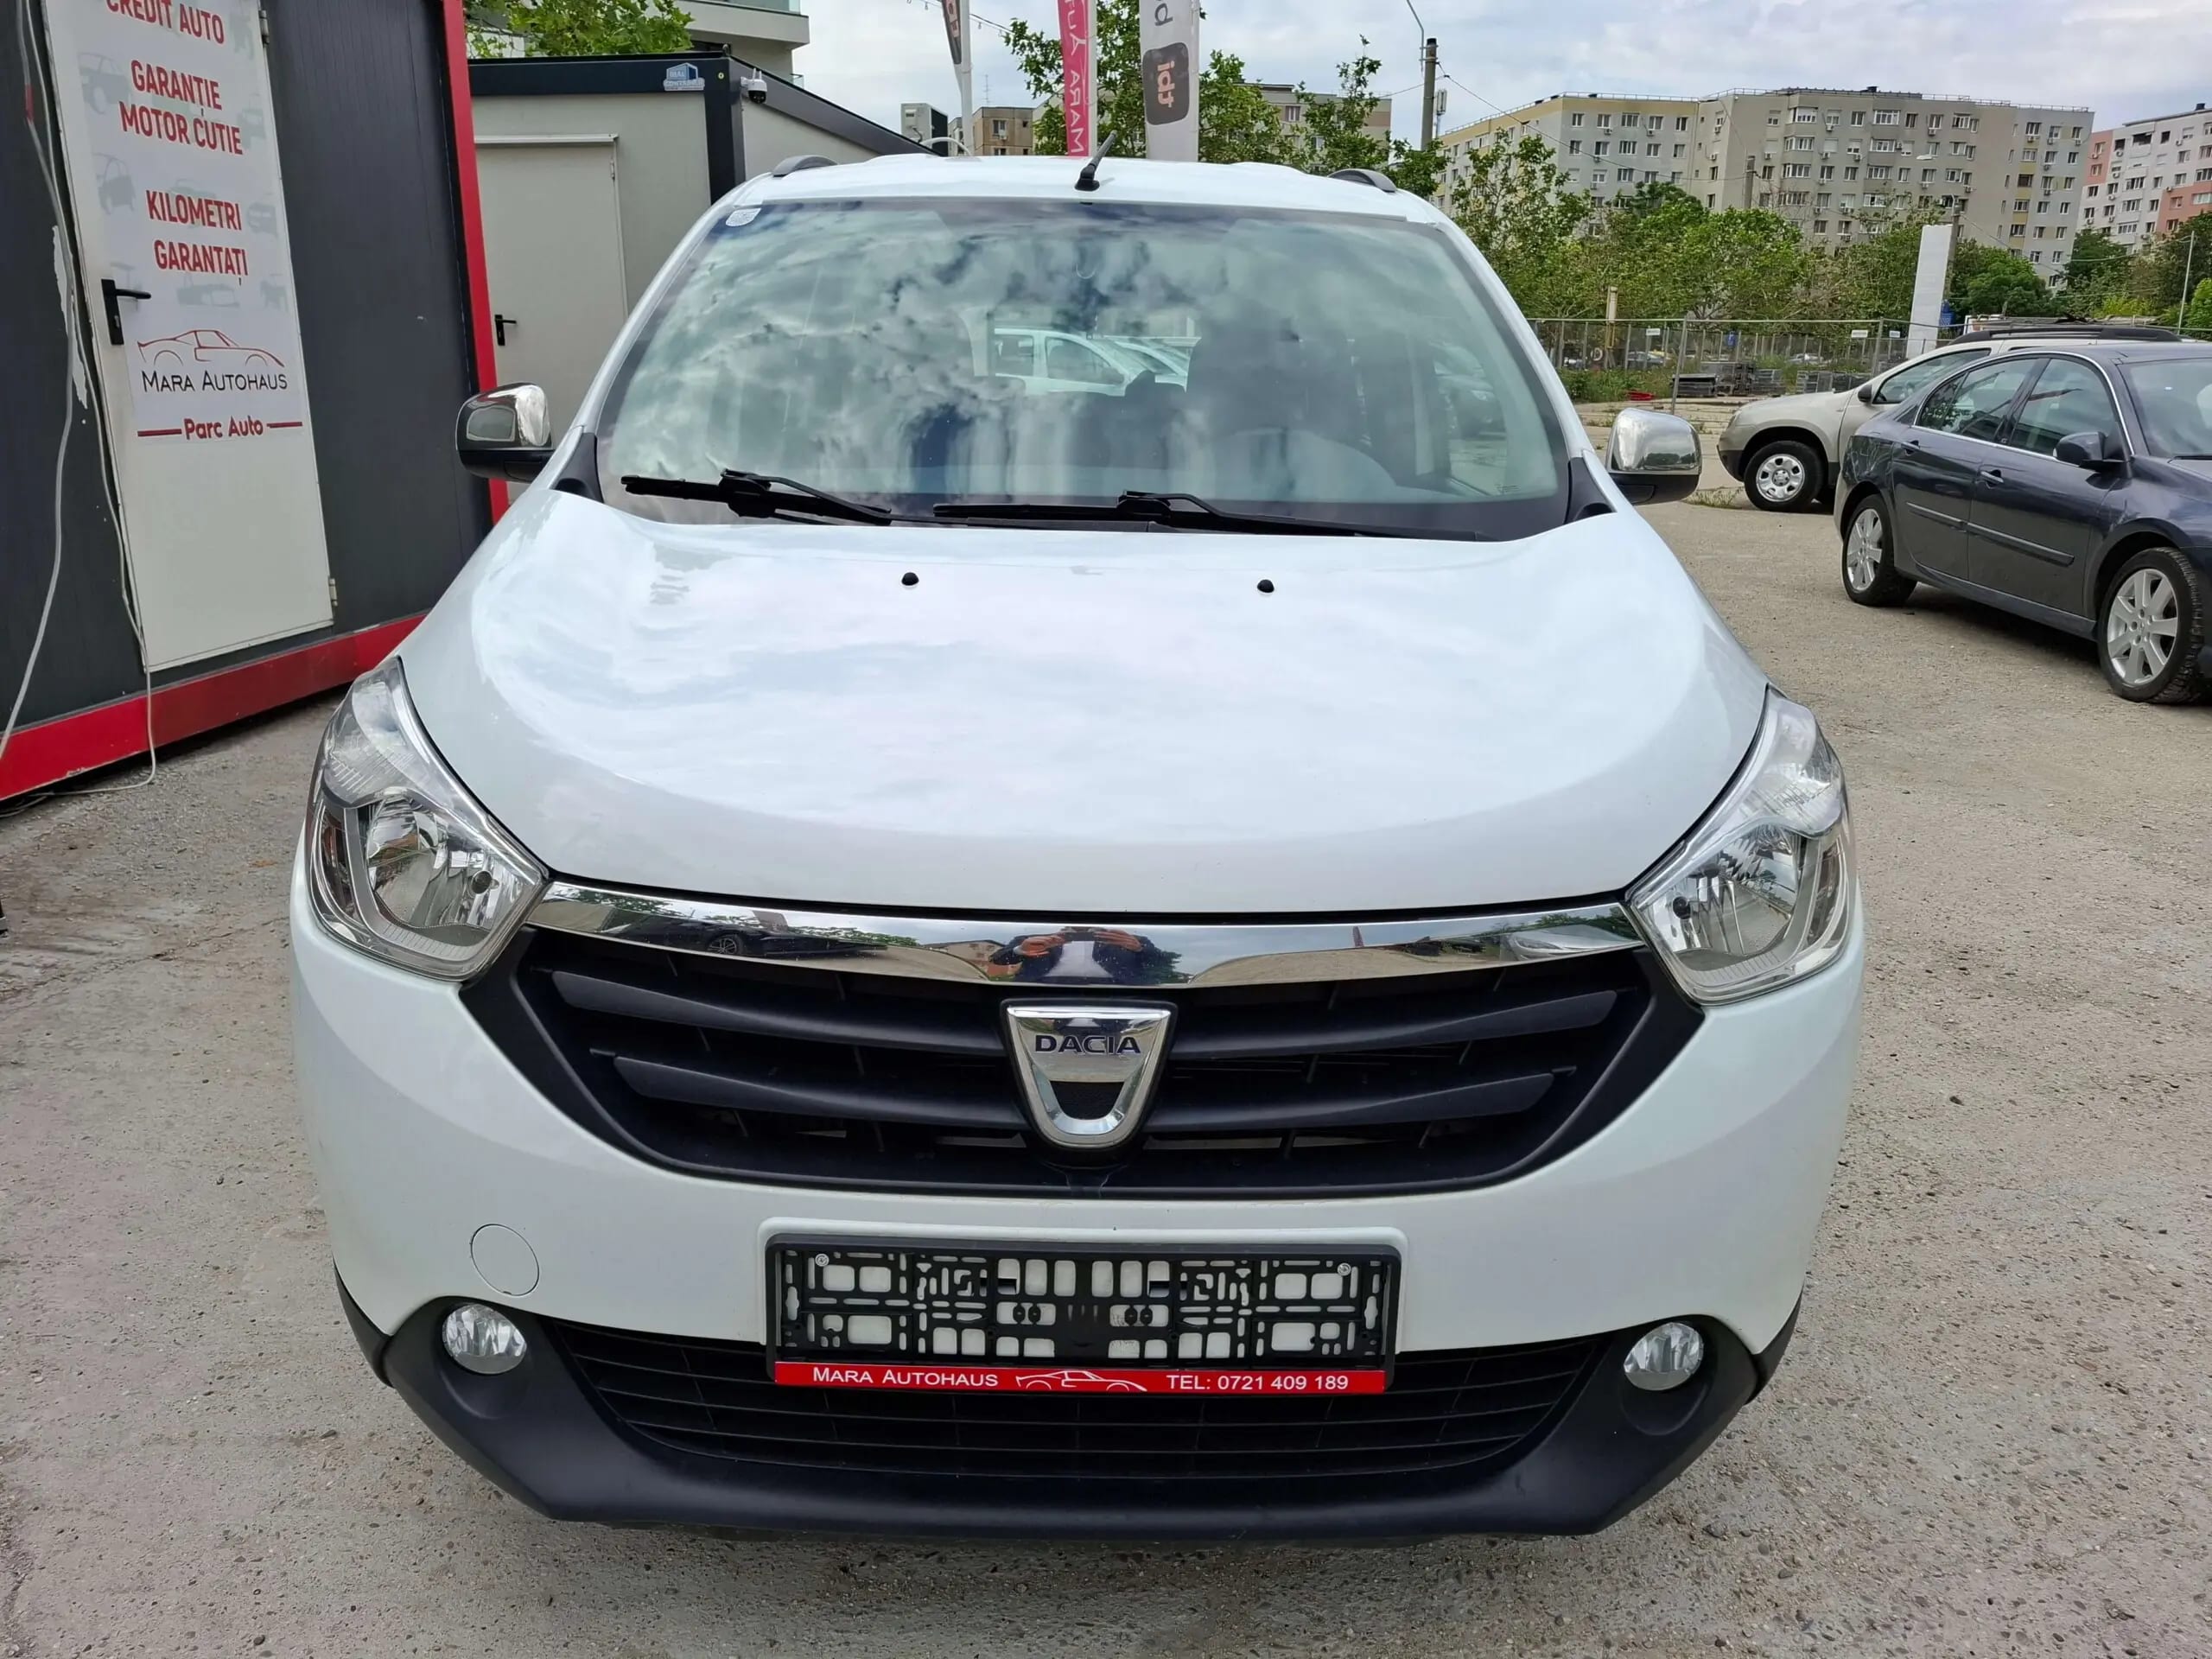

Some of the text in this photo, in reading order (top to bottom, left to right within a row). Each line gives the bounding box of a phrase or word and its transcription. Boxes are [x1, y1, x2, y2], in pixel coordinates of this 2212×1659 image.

[180, 3, 225, 44] AUTO
[131, 60, 222, 117] GARANȚIE
[119, 101, 243, 155] MOTOR CUTIE
[146, 190, 242, 231] KILOMETRI
[154, 240, 249, 286] GARANTAȚI
[142, 370, 288, 392] MARA AUTOHAUS
[183, 416, 264, 440] Parc Auto
[1035, 1034, 1141, 1054] DACIA
[813, 1367, 1349, 1390] MARA AUTOHAUS TEL: 0721 409 189
